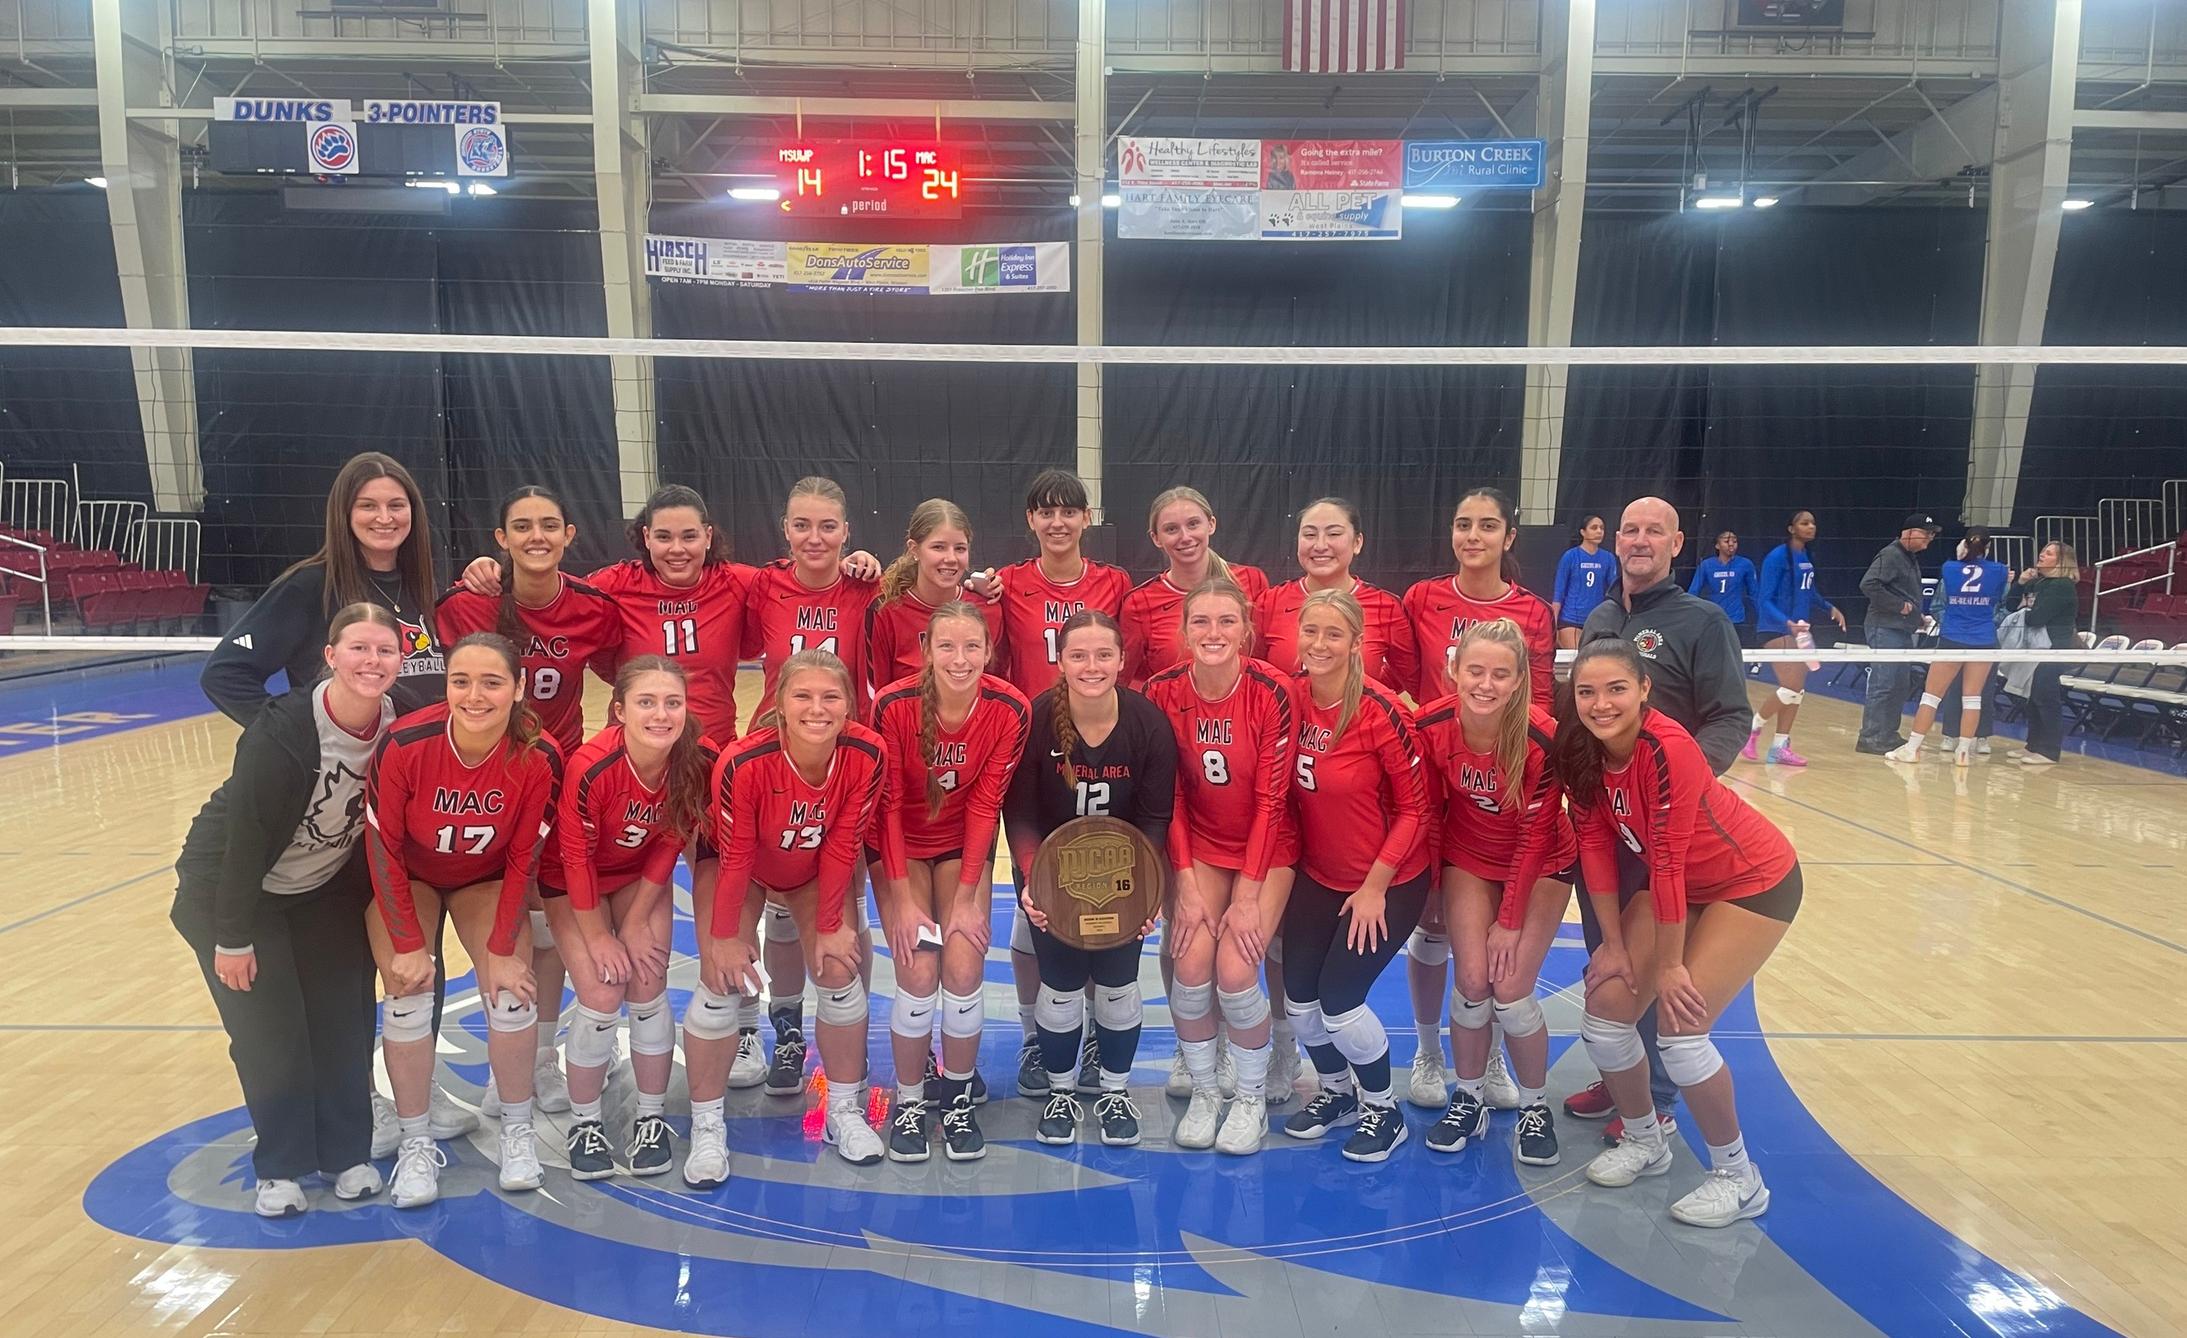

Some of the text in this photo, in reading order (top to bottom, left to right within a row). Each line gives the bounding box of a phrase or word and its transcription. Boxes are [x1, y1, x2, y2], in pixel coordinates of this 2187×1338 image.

[234, 101, 333, 121] DUNKS
[368, 102, 496, 124] 3-POINTERS
[779, 149, 813, 162] MSUWP
[915, 151, 936, 164] MAC
[1149, 141, 1256, 161] Healthy Lifestyles
[1301, 148, 1324, 157] Going
[1325, 148, 1339, 156] the
[1362, 148, 1383, 156] mile?
[1411, 147, 1533, 162] BURTON CREEK
[1468, 164, 1495, 175] Rural
[1497, 163, 1528, 175] Clinic
[798, 168, 821, 196] 14
[922, 169, 957, 199] 24
[853, 198, 886, 213] period
[1288, 192, 1377, 211] ALL PET
[1340, 212, 1369, 222] supply
[646, 239, 707, 275] HIRSCH
[806, 255, 910, 269] DonsAutoService
[1001, 254, 1024, 262] Holiday
[1001, 263, 1034, 273] Express
[1586, 571, 1594, 587] 9
[1720, 579, 1726, 593] 1
[1960, 565, 1983, 593] 2
[658, 599, 697, 616] MAC
[796, 605, 838, 632] MAC
[1045, 600, 1084, 623] MAC
[520, 635, 569, 659] AC
[662, 618, 699, 656] 11
[790, 634, 838, 656] 14
[1043, 628, 1058, 665] 1
[398, 659, 446, 674] EYBALL
[1197, 718, 1233, 745] MAC
[1299, 720, 1332, 753] MAC
[933, 741, 967, 767] MAC
[1056, 762, 1130, 780] MNERAL AREA
[1202, 749, 1231, 786] 8
[1296, 753, 1318, 792] 5
[1460, 762, 1497, 792] MAC
[937, 769, 959, 792] 4
[432, 787, 504, 816] MAC
[1076, 781, 1110, 816] 12
[1469, 793, 1501, 815] 2
[623, 799, 664, 825] MAC
[435, 824, 497, 855] 17
[614, 823, 650, 850] 3
[779, 824, 826, 852] 13
[1059, 845, 1133, 886] NJCAA
[1115, 879, 1131, 891] 16
